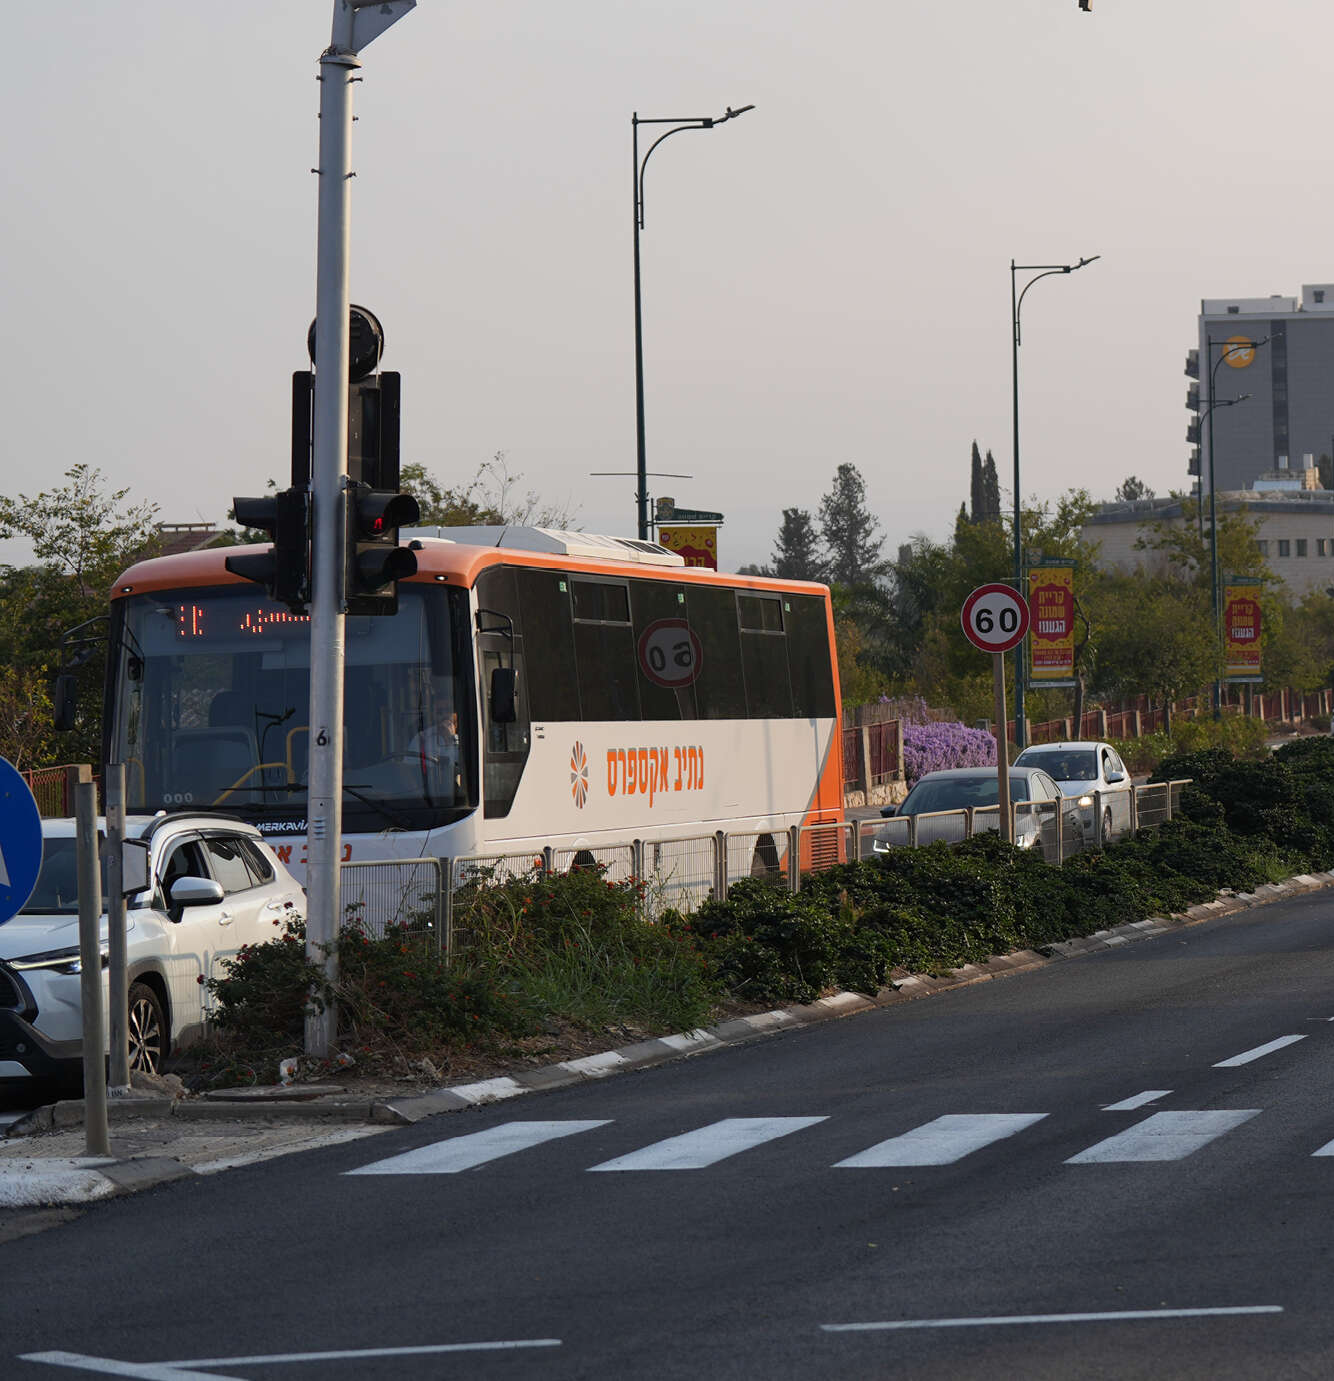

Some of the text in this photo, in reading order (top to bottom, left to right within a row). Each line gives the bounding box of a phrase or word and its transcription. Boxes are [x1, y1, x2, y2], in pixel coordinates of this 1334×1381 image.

[975, 608, 1018, 633] 60
[606, 745, 704, 808] נתיב אקספרס
